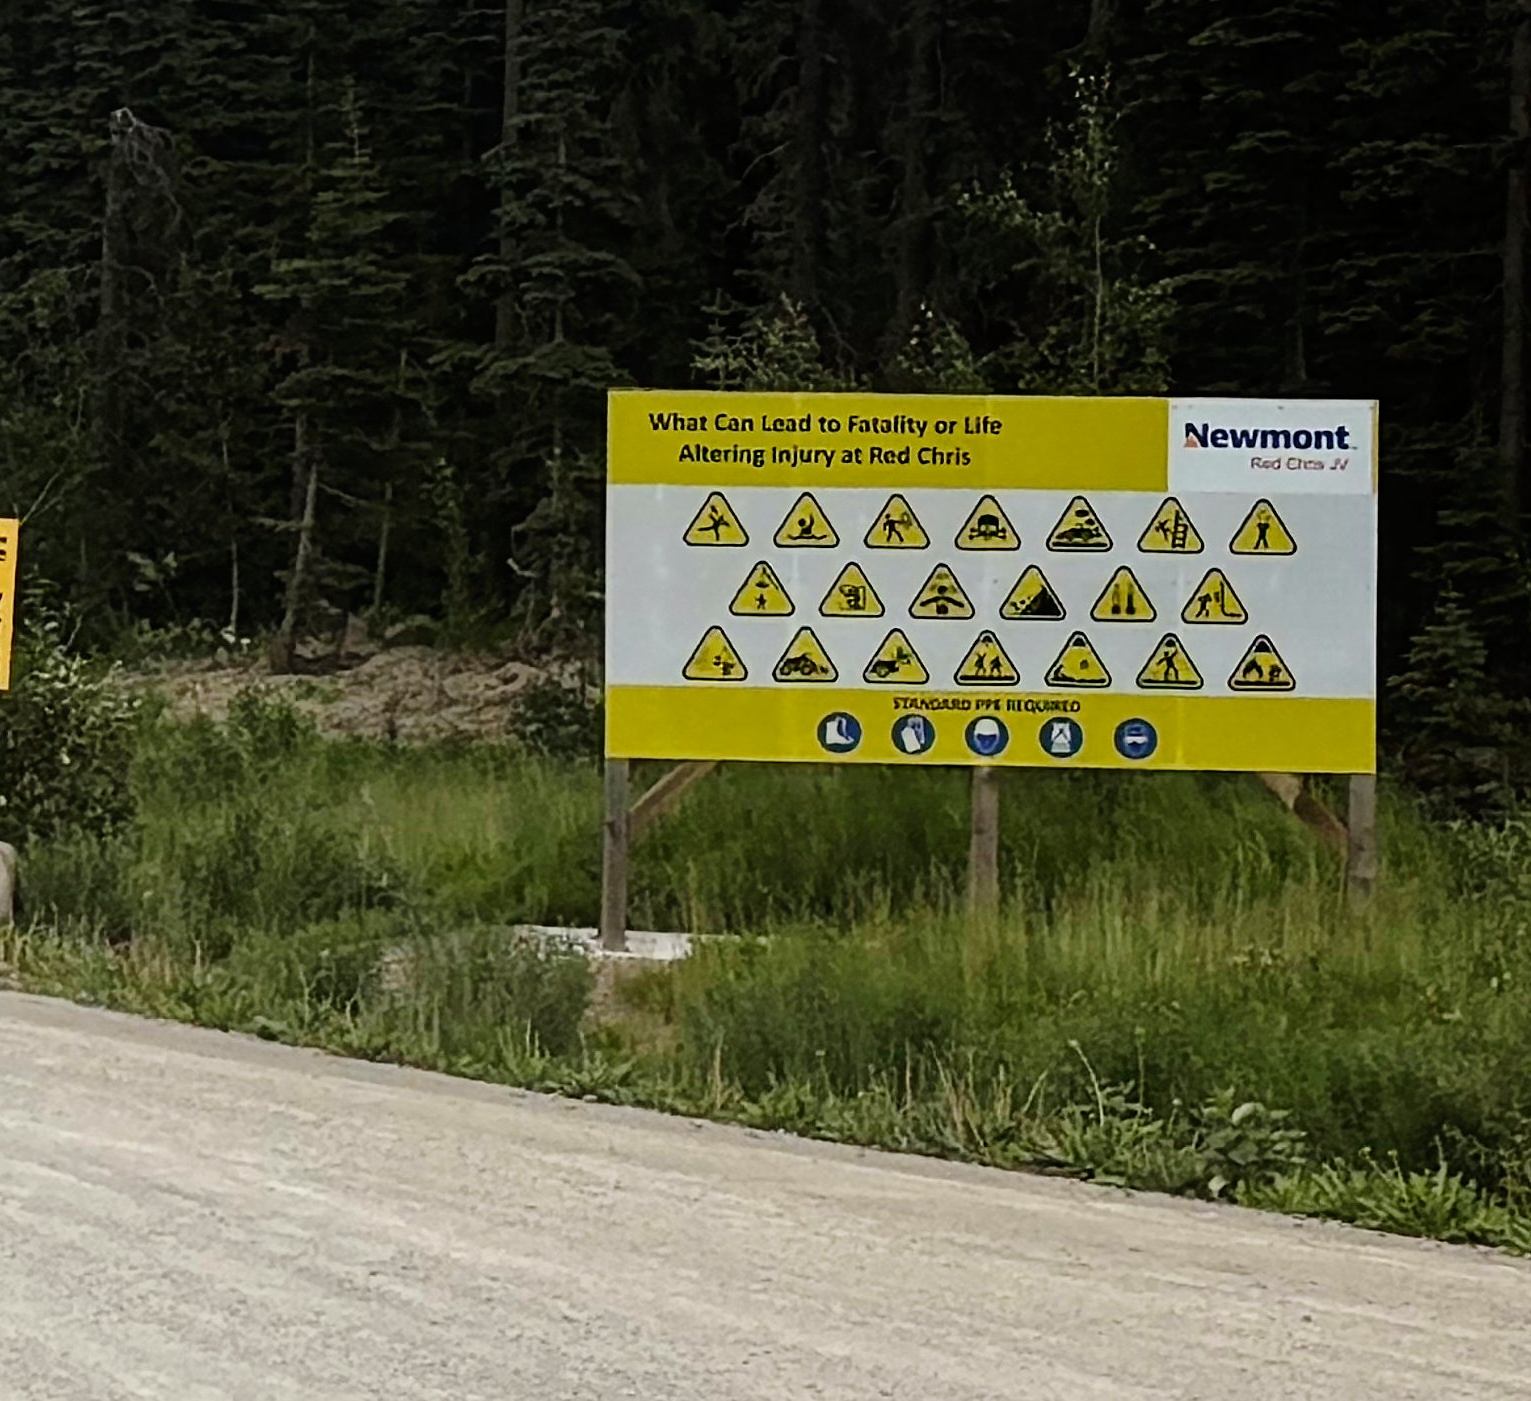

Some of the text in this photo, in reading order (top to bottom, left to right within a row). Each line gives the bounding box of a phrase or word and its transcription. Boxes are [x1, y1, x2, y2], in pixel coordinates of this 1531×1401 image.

[648, 413, 1003, 438] What Can Lead to Fatality or Life
[1183, 422, 1351, 450] Newmont
[679, 444, 972, 468] Altering Injury at Red Chris
[1250, 456, 1281, 471] Red
[1006, 698, 1081, 714] REQUIRED
